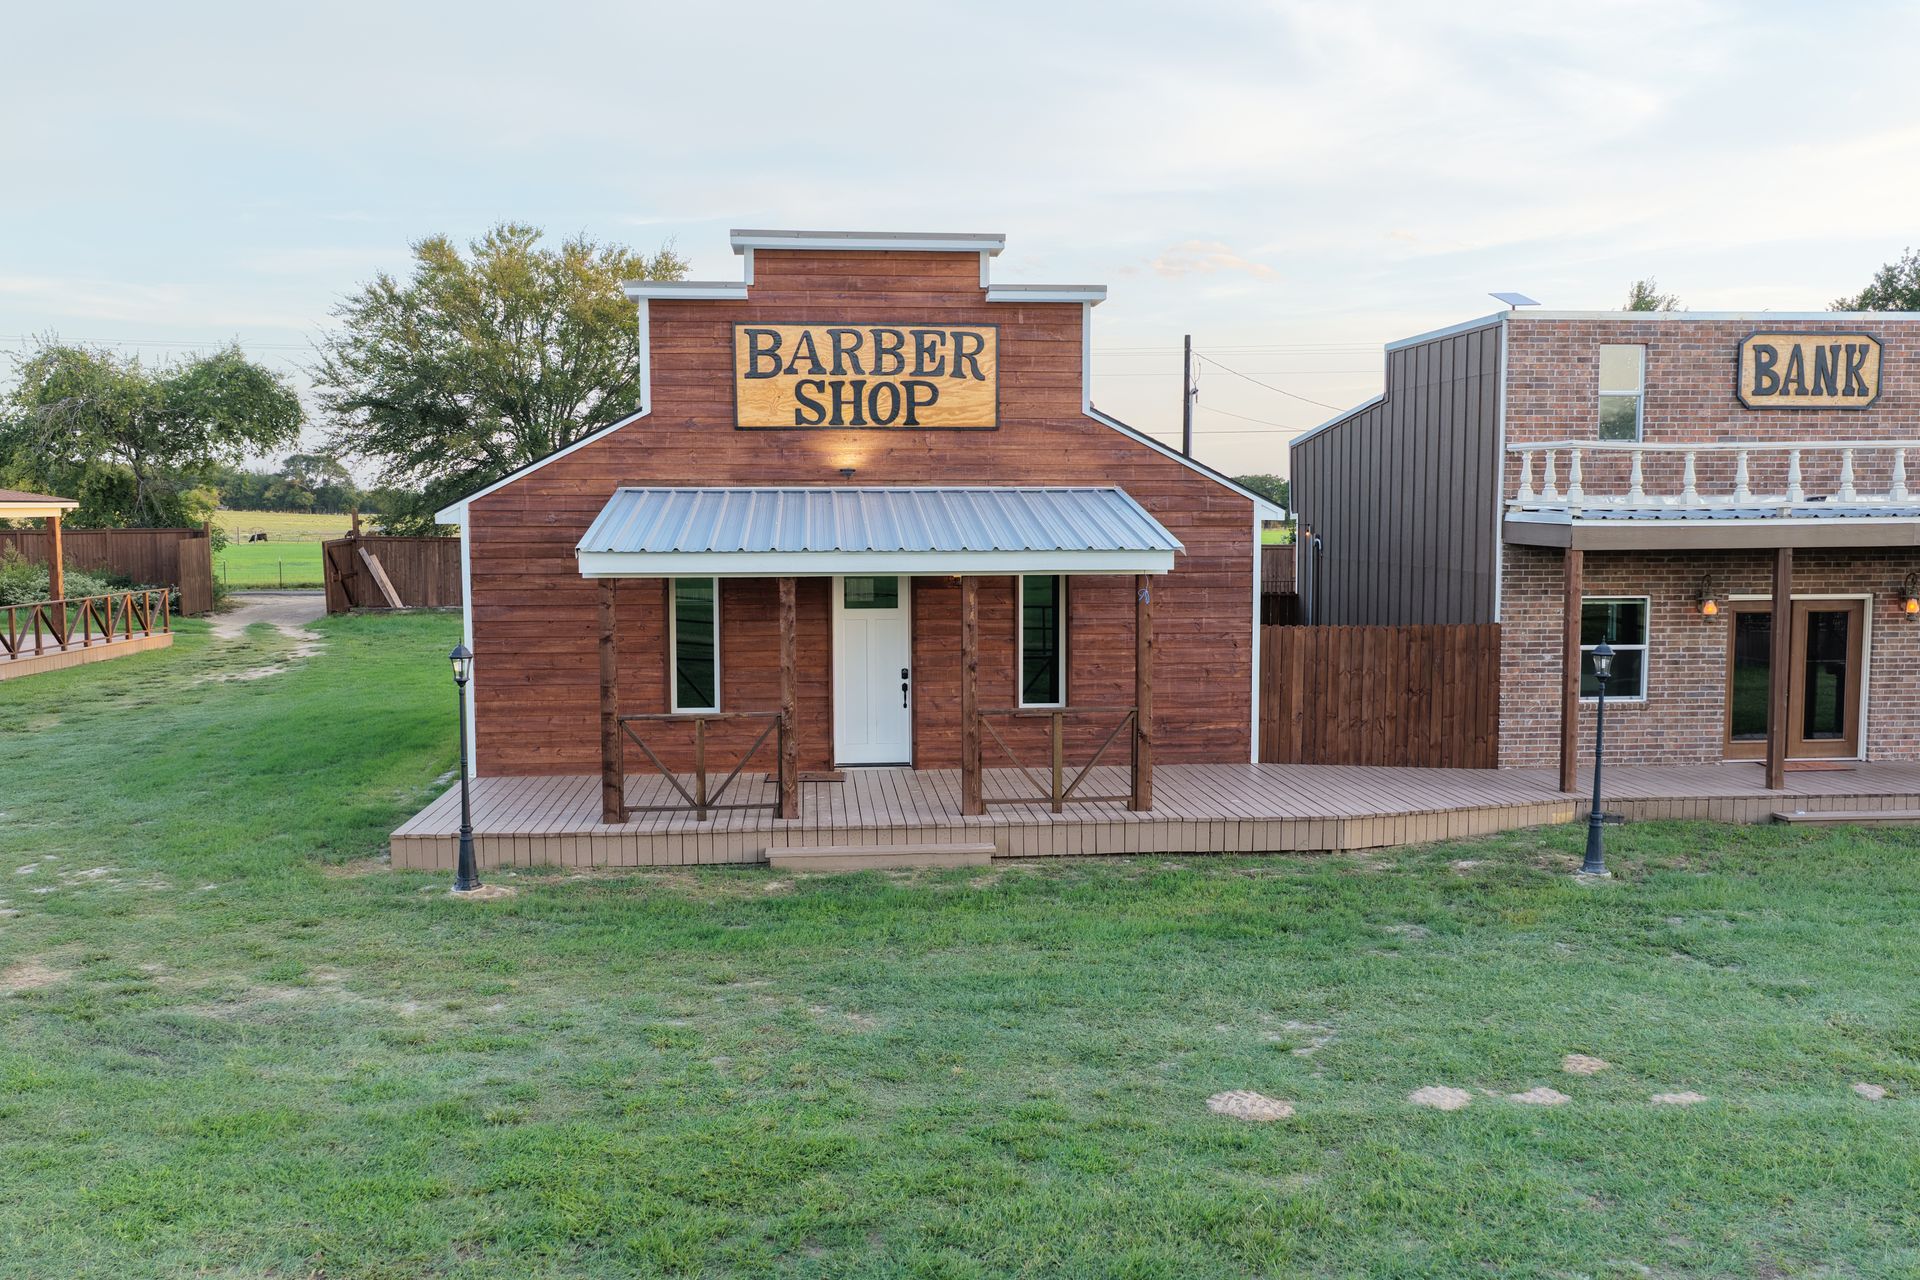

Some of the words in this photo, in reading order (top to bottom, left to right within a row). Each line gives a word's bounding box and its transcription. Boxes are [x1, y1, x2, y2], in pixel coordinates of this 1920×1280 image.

[744, 328, 986, 381] BARBER
[1751, 343, 1871, 397] BANK
[794, 379, 939, 426] SHOP
